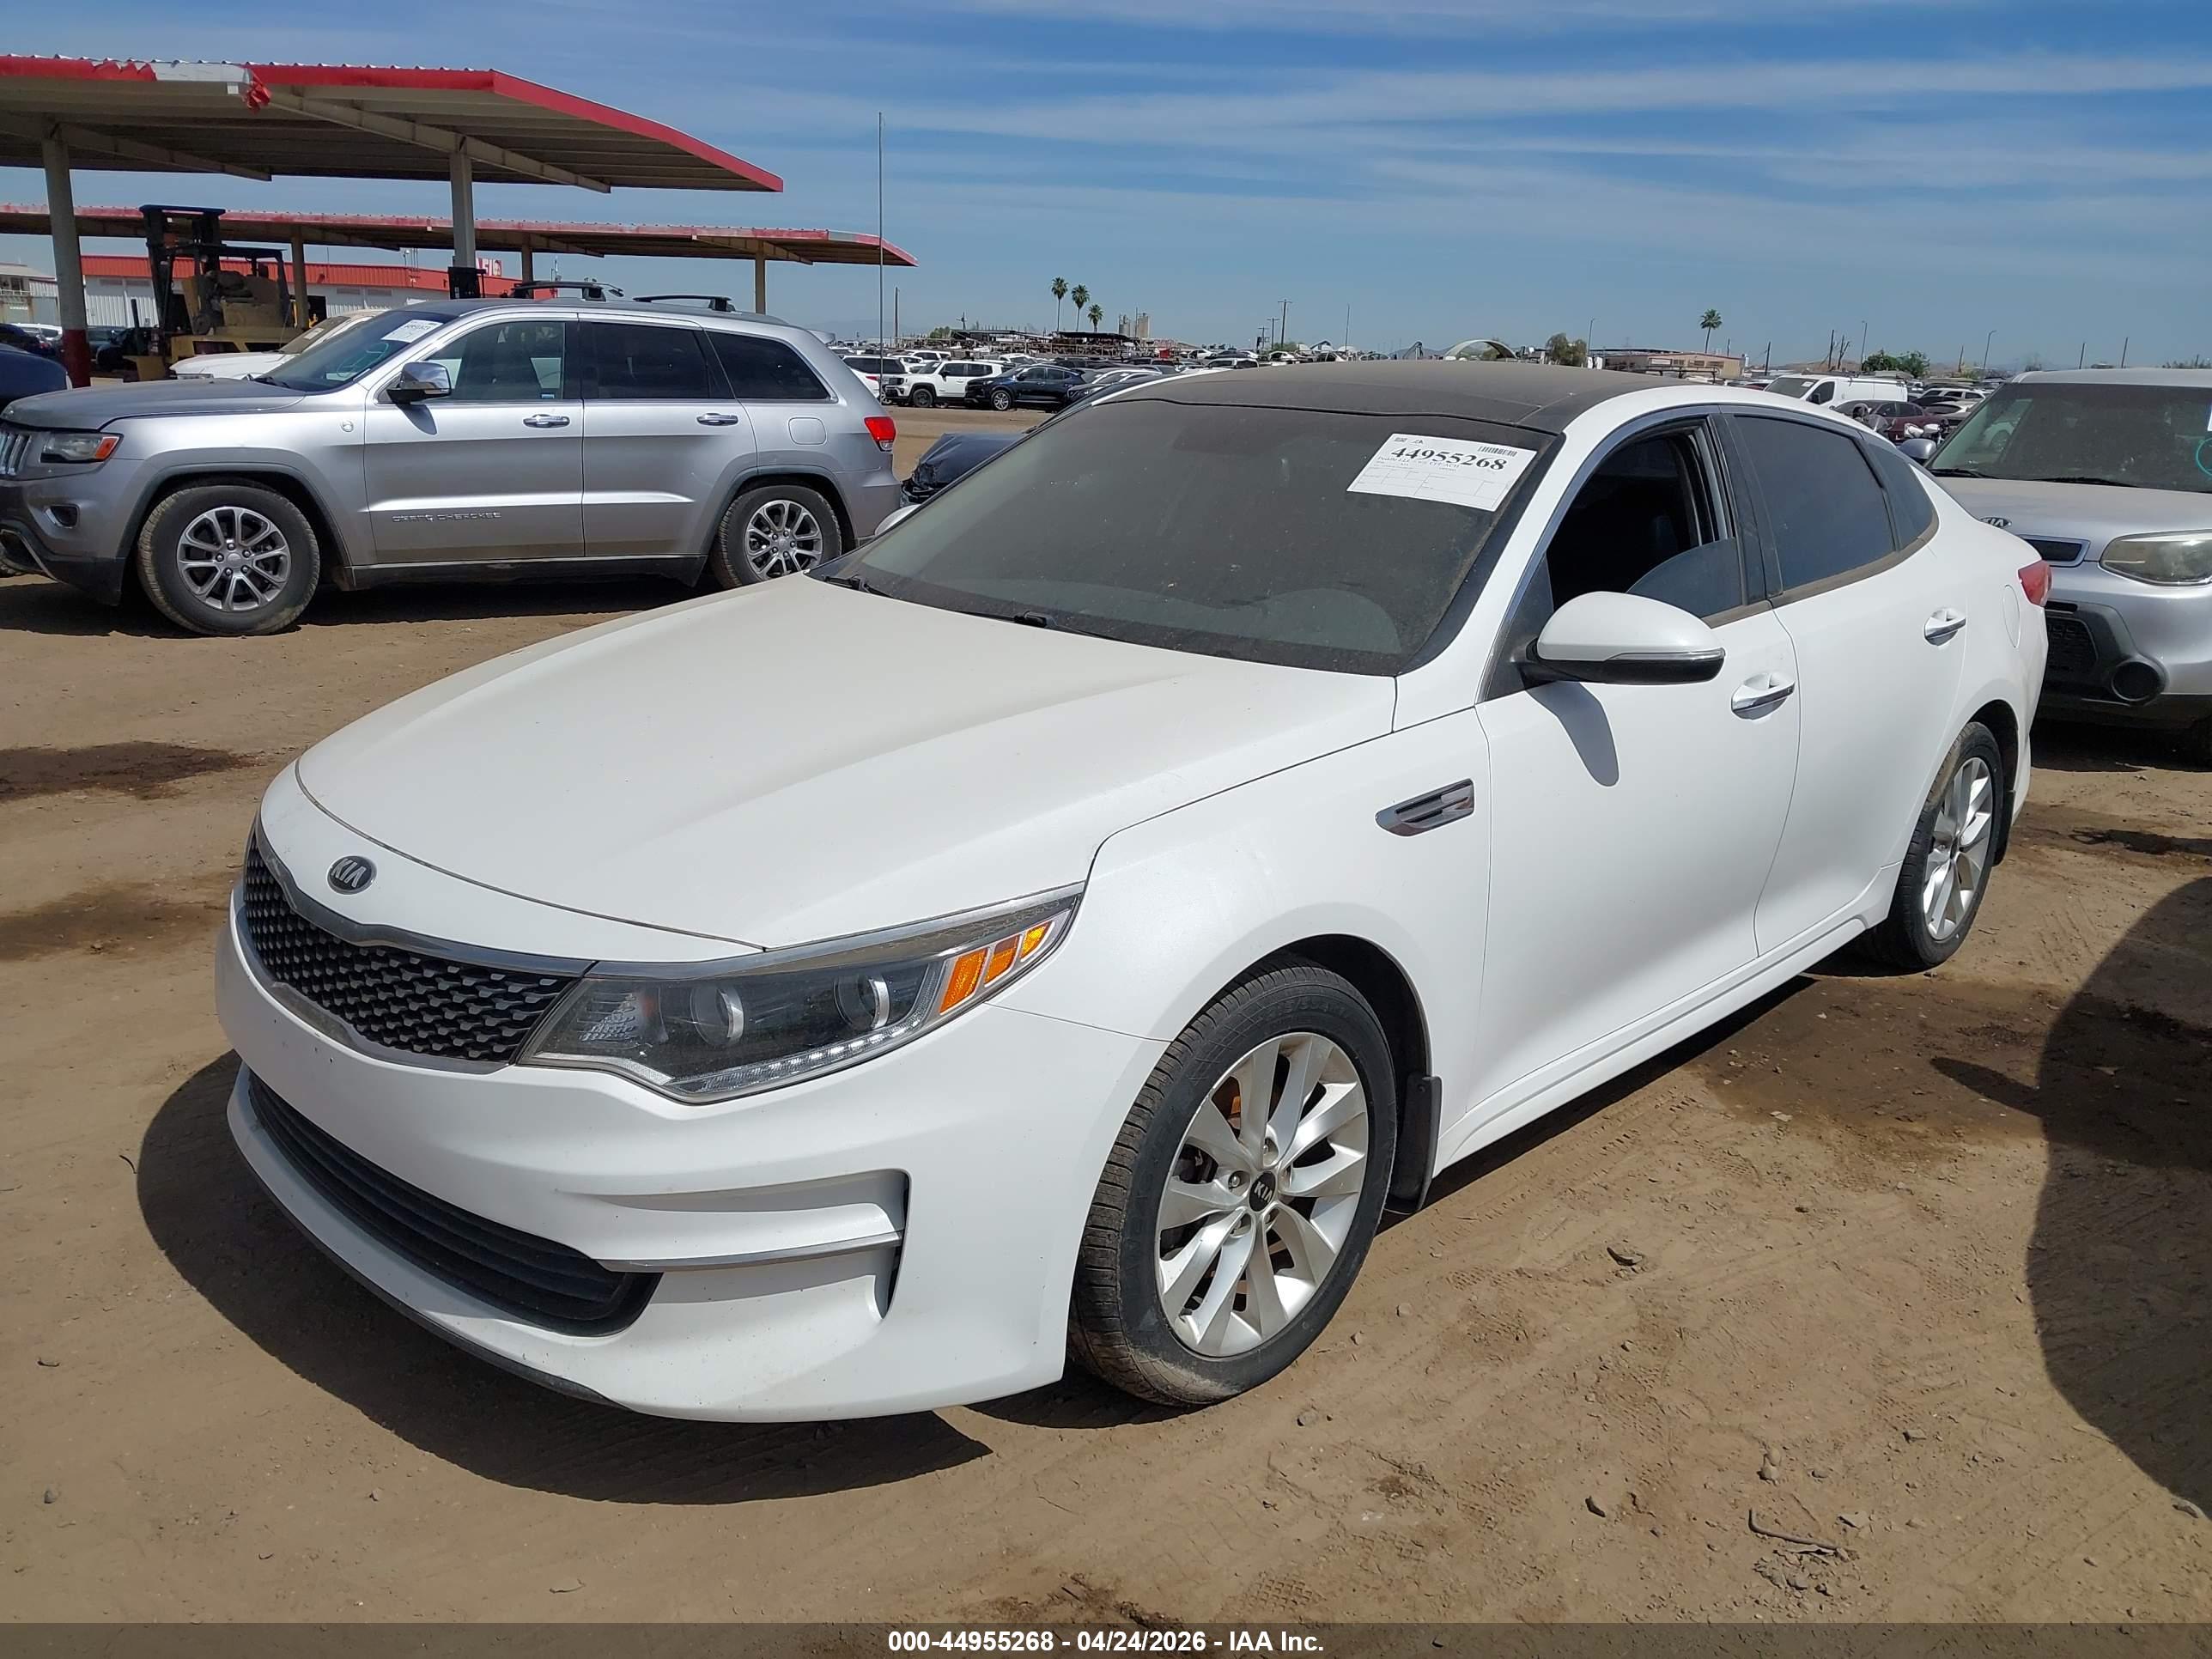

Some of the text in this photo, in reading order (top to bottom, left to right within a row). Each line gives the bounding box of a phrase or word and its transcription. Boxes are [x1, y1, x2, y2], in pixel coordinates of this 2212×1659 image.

[1391, 447, 1508, 471] 44955268
[331, 859, 367, 888] KIA
[1254, 1181, 1273, 1203] KIA
